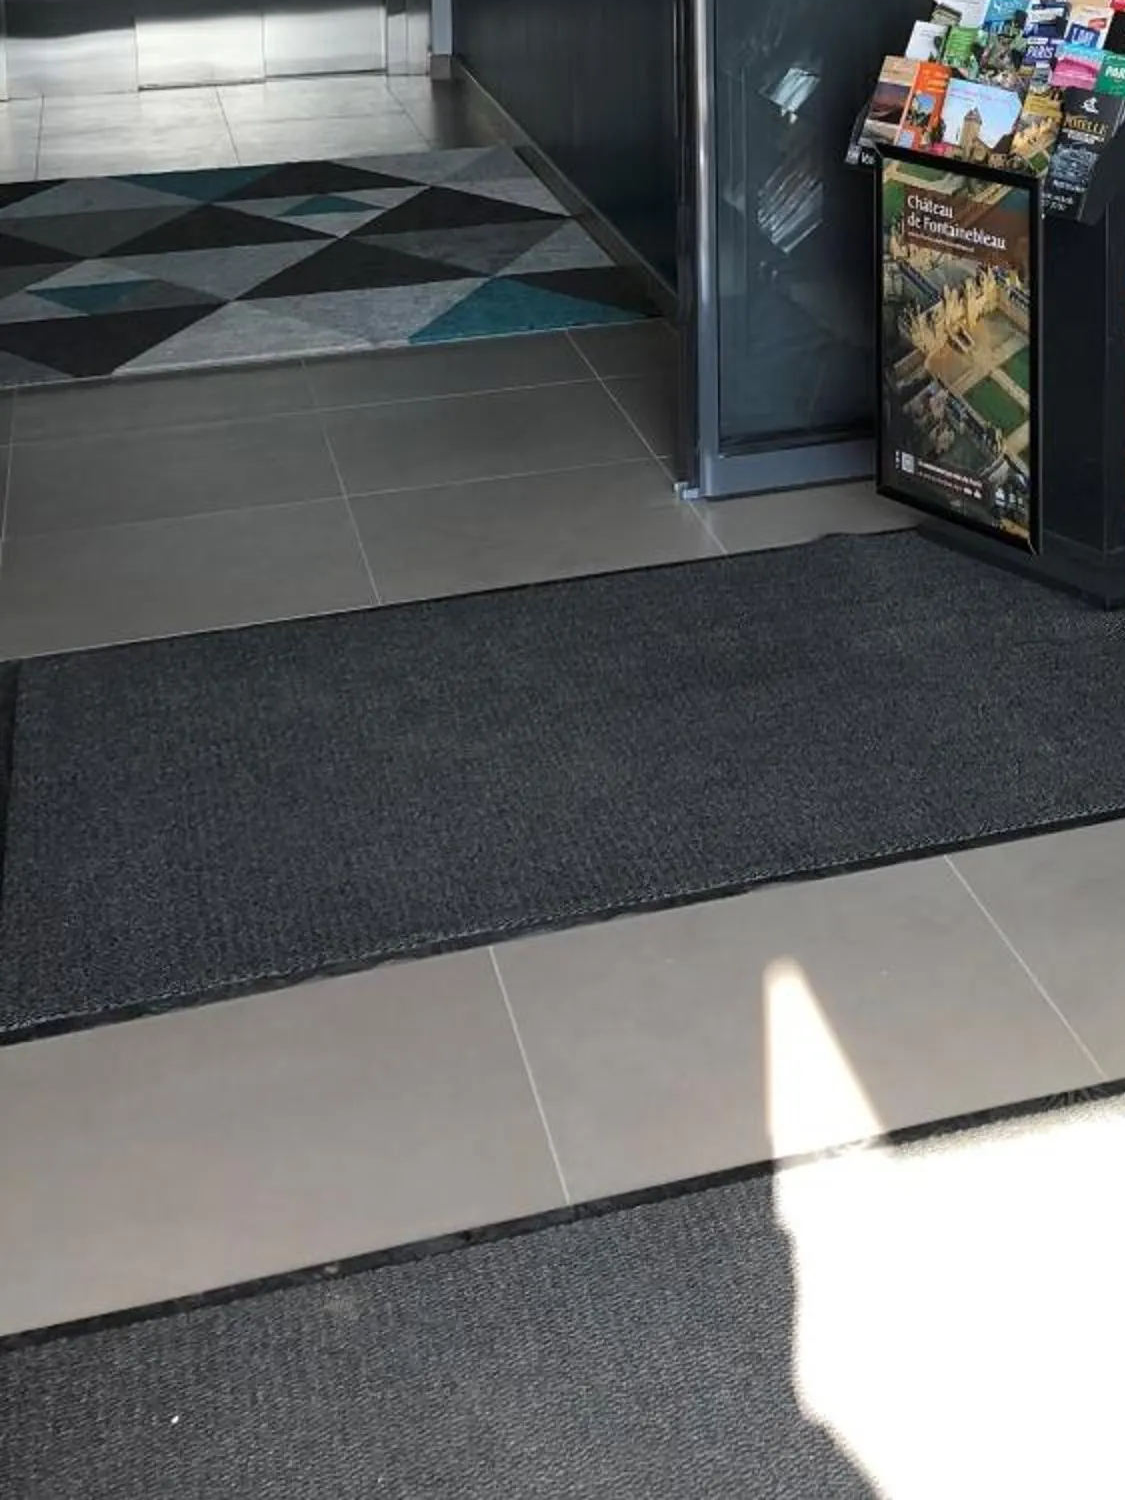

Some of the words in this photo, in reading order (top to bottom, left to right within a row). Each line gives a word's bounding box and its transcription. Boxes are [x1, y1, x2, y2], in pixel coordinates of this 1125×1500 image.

[907, 195, 953, 218] Château
[907, 212, 921, 229] de
[923, 215, 1007, 251] Fontainebleau
